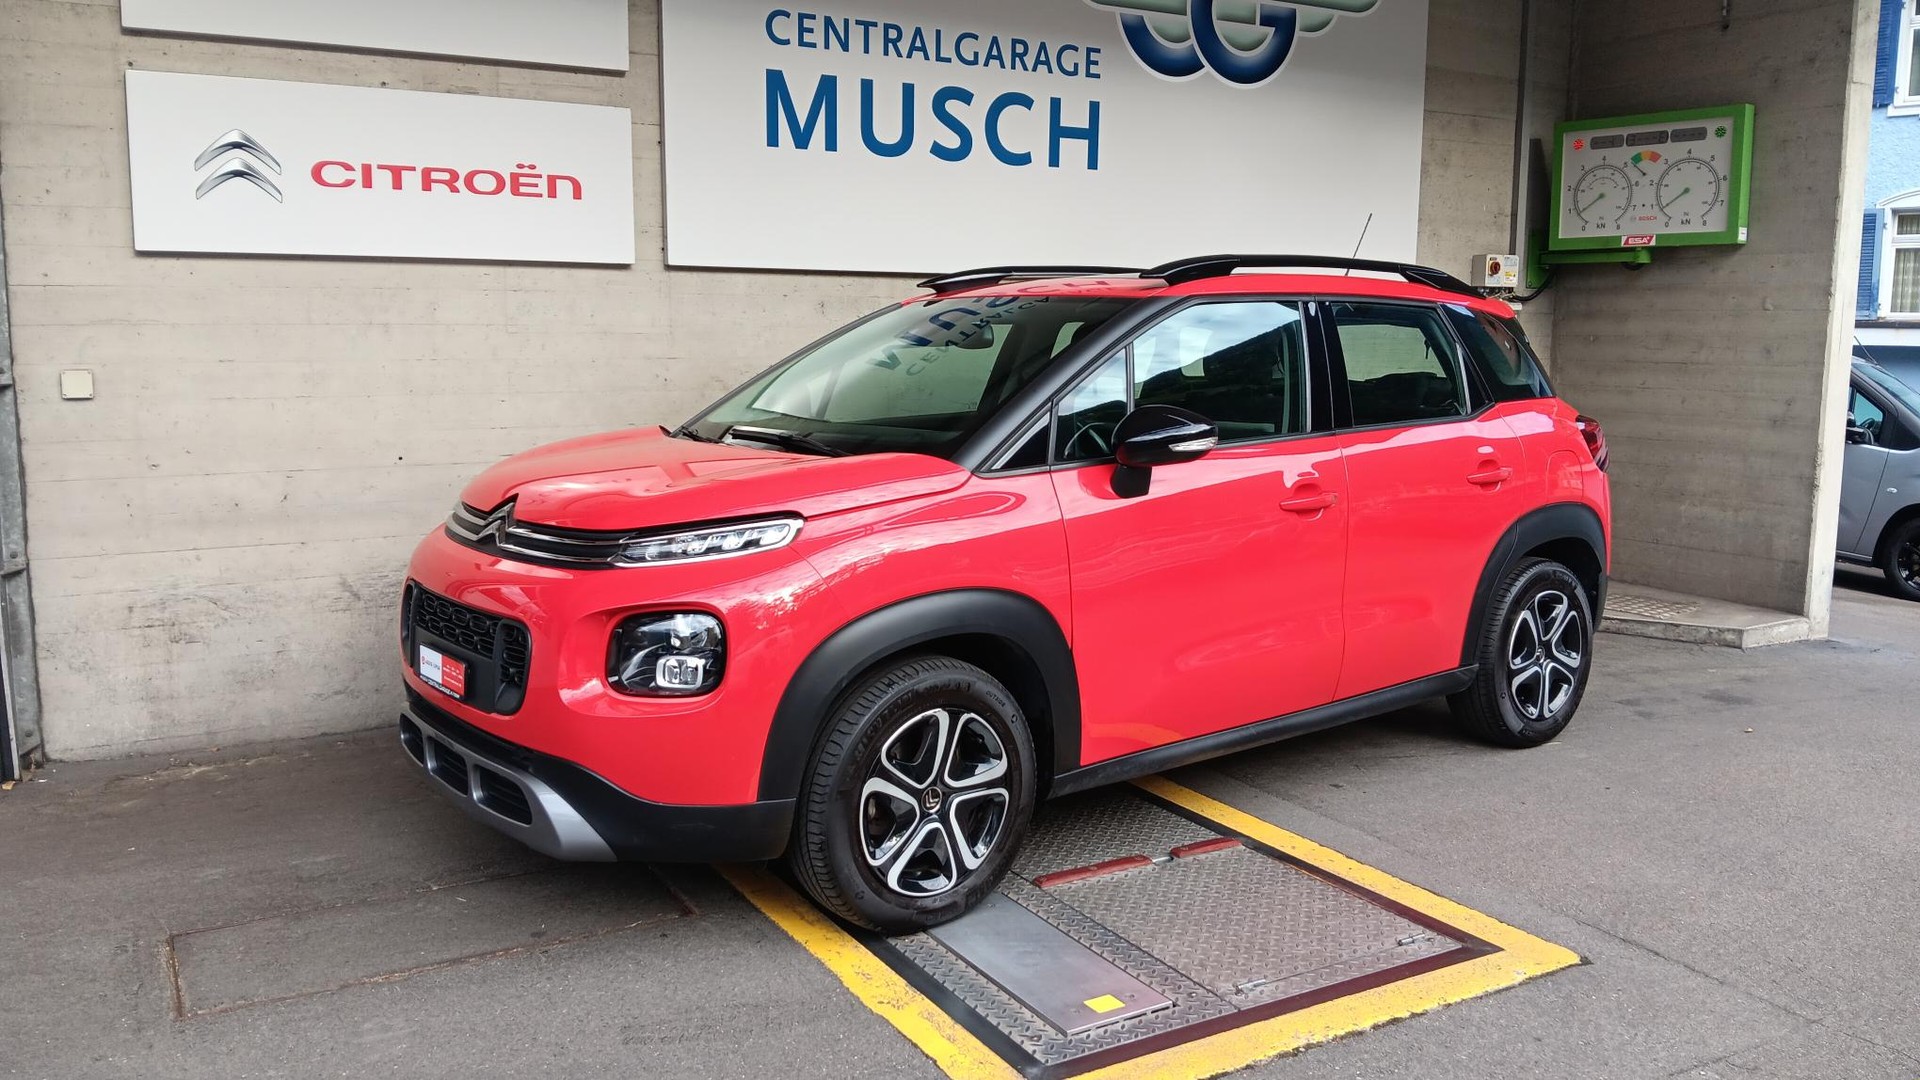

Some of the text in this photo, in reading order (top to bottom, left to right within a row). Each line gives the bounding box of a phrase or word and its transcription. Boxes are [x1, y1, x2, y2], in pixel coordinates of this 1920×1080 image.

[765, 9, 1101, 80] CENTRALGARAGE
[766, 68, 1100, 171] MUSCH
[310, 159, 583, 201] CITROËN
